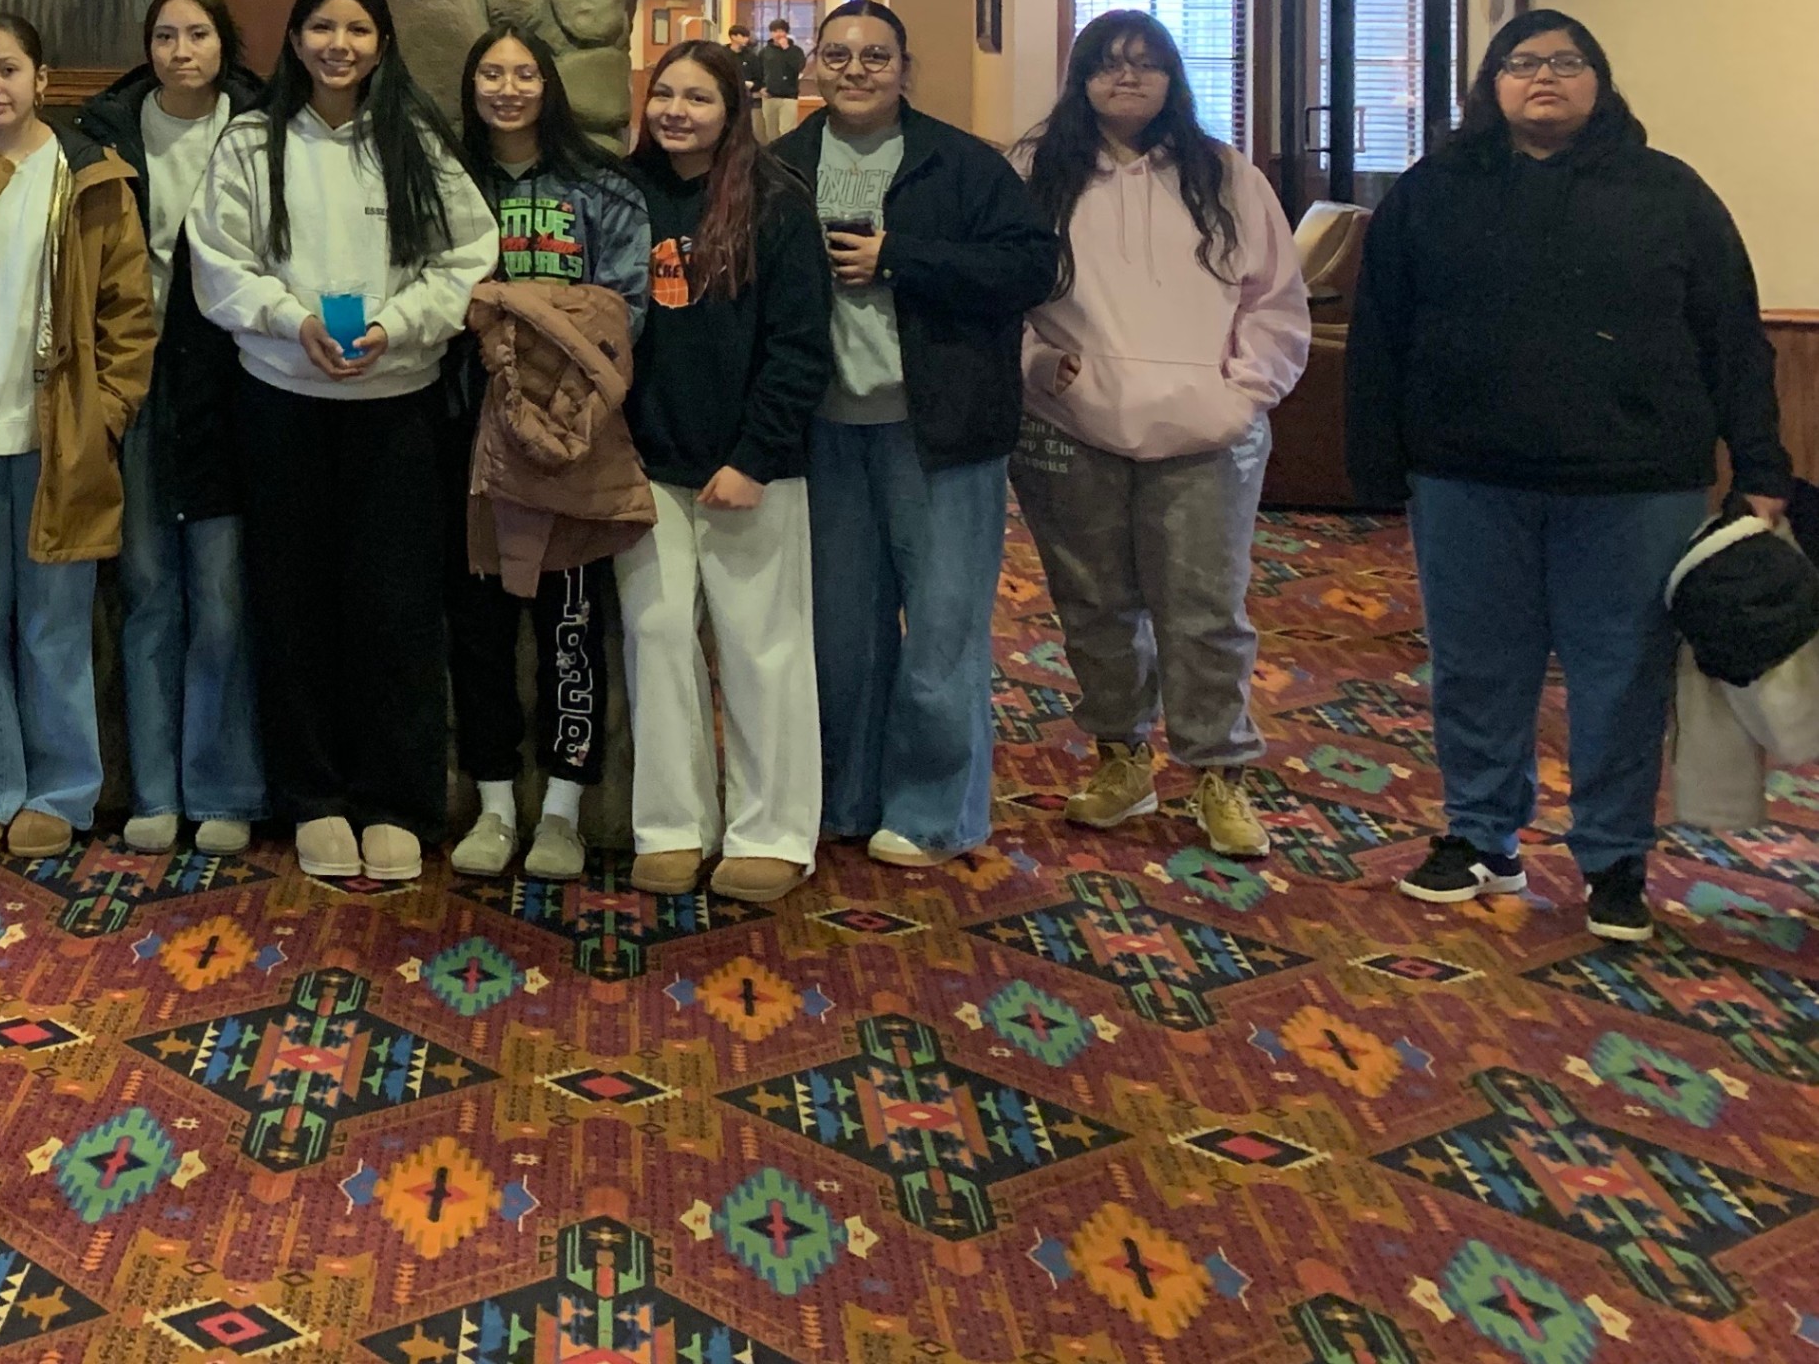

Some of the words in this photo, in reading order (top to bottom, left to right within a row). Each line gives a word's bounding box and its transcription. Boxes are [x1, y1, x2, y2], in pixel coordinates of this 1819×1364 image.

[364, 207, 386, 216] ESSE
[501, 207, 576, 244] TIVE
[655, 263, 682, 279] CKE
